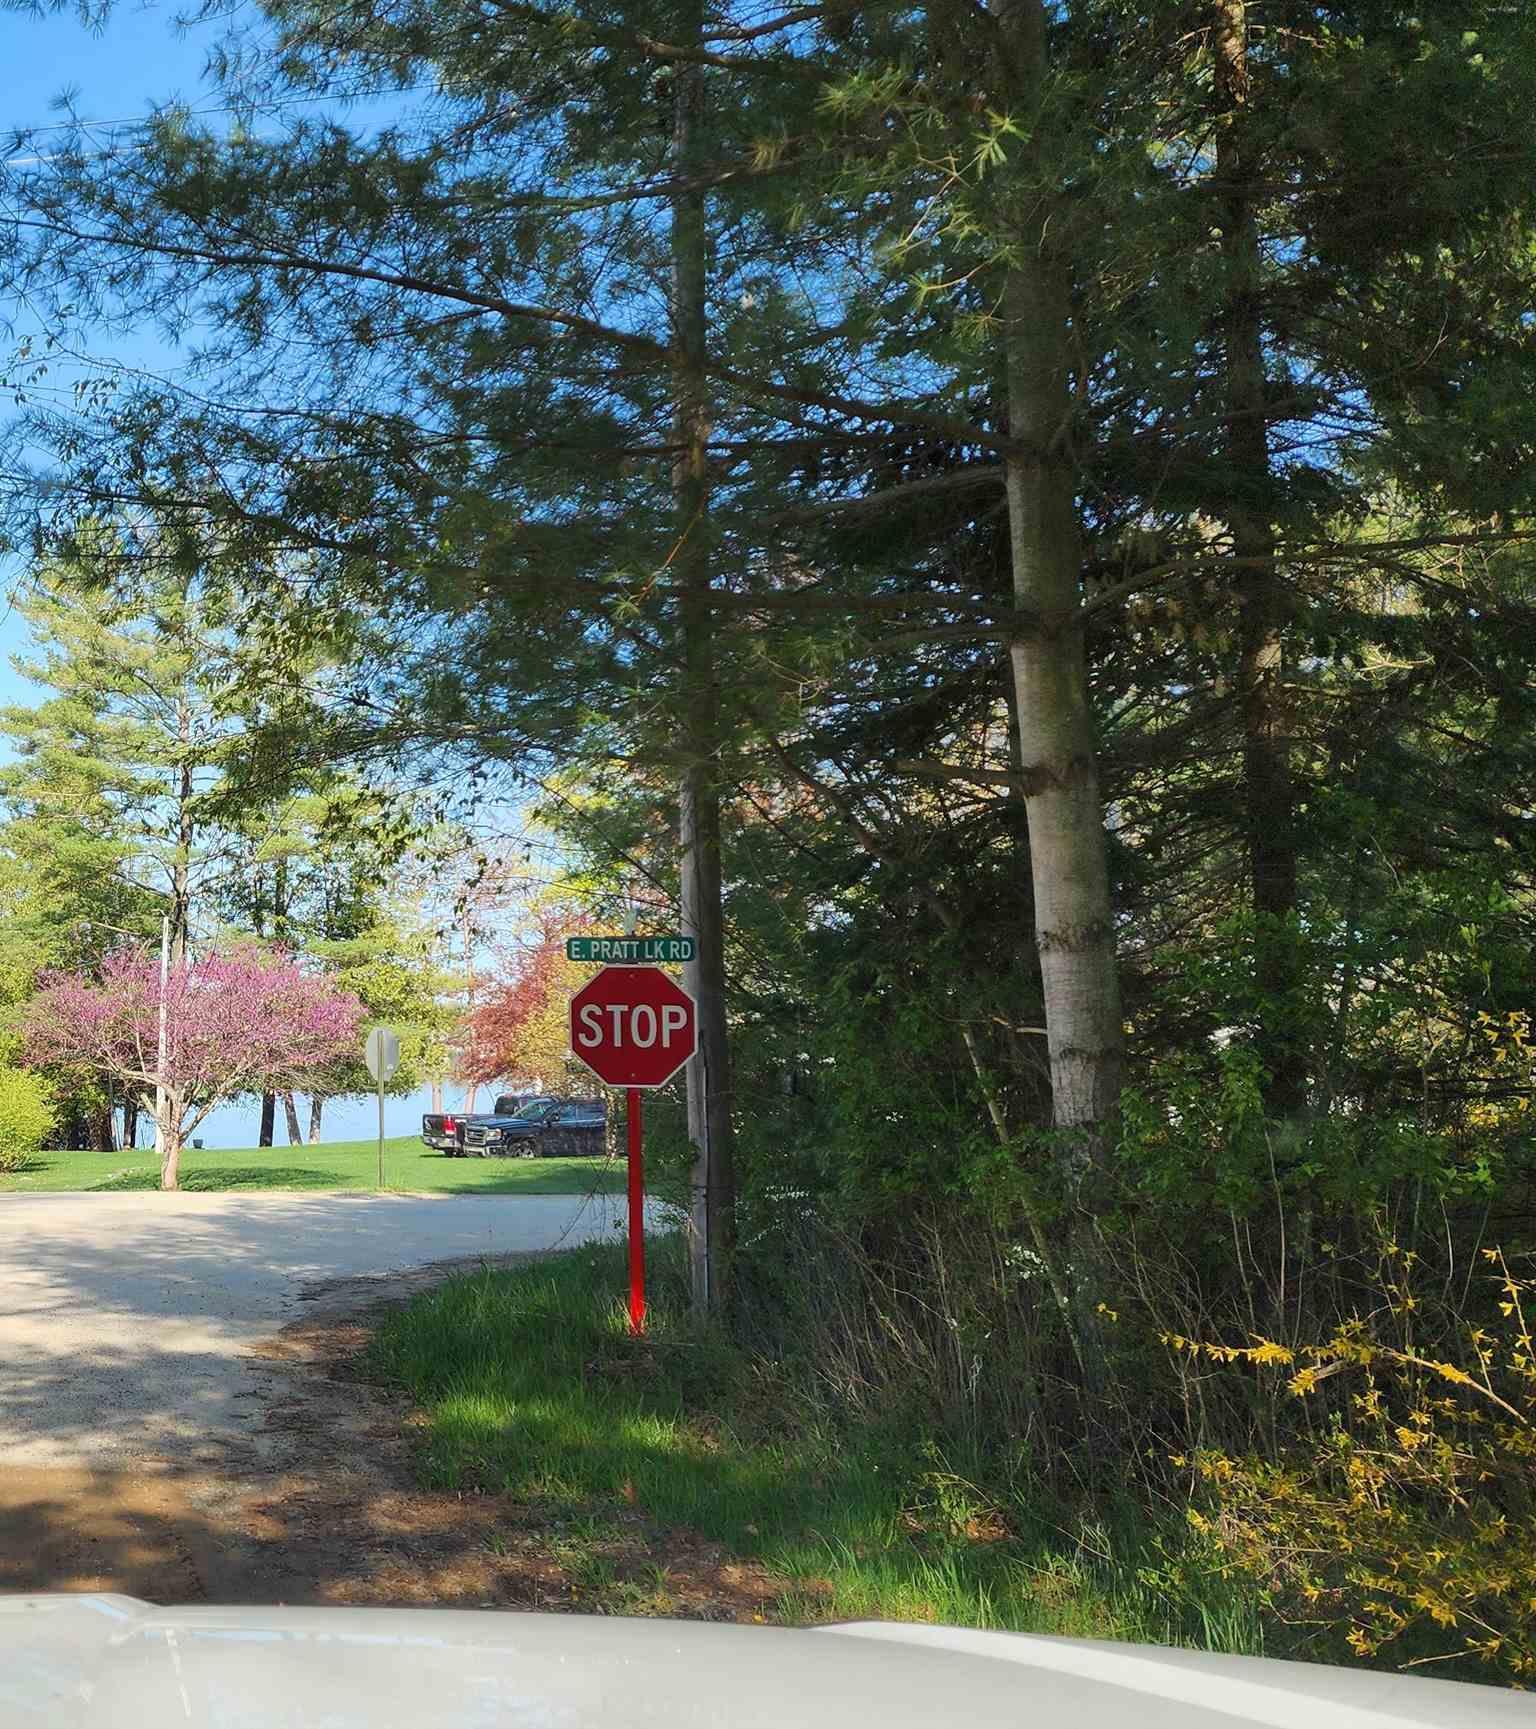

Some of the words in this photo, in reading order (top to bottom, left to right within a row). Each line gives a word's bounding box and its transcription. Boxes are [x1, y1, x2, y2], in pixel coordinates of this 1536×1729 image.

[571, 941, 585, 959] E.
[591, 941, 639, 959] PRATT
[645, 941, 664, 959] LK
[670, 941, 692, 959] RD
[578, 1003, 688, 1048] STOP
